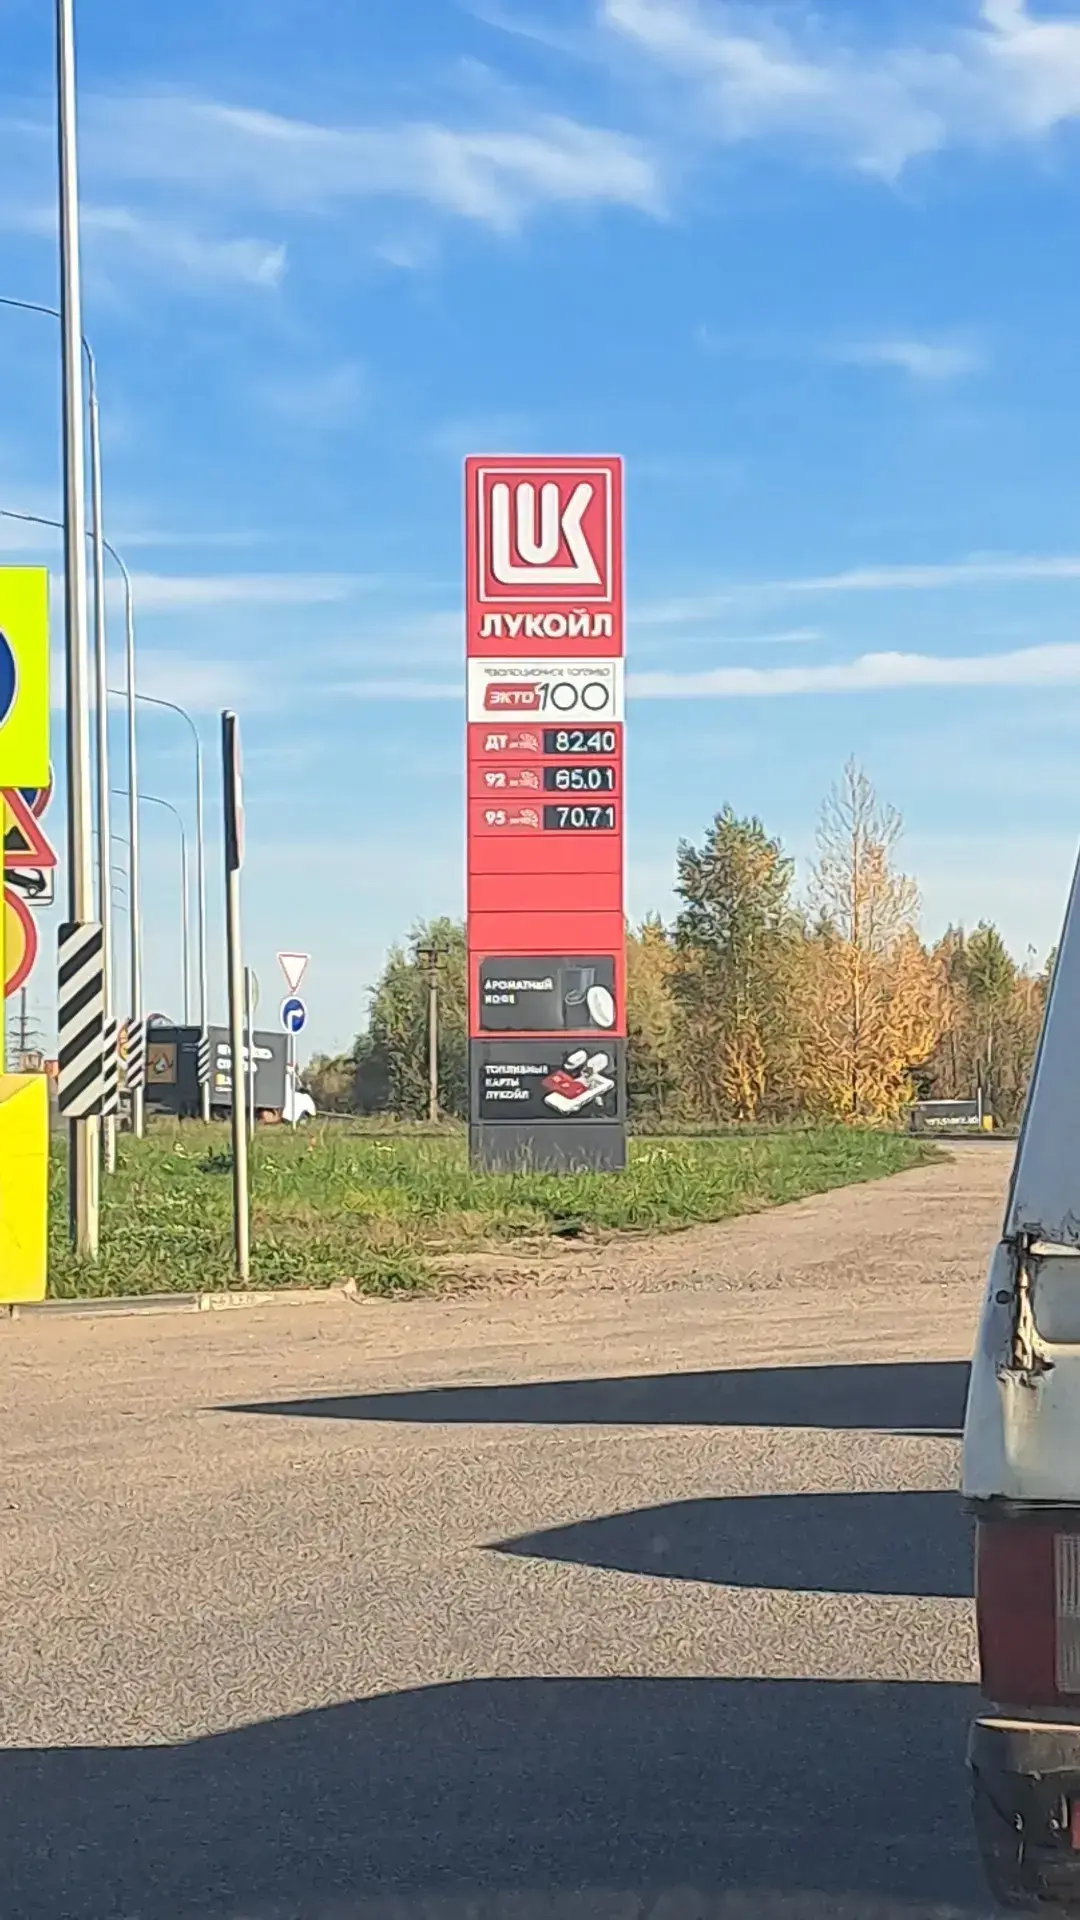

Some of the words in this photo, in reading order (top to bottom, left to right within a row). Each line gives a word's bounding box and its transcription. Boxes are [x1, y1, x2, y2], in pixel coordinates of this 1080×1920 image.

[480, 608, 613, 637] ЛУКОЙЛ
[485, 734, 508, 751] ДТ
[485, 773, 506, 788] 92
[485, 811, 506, 826] 95
